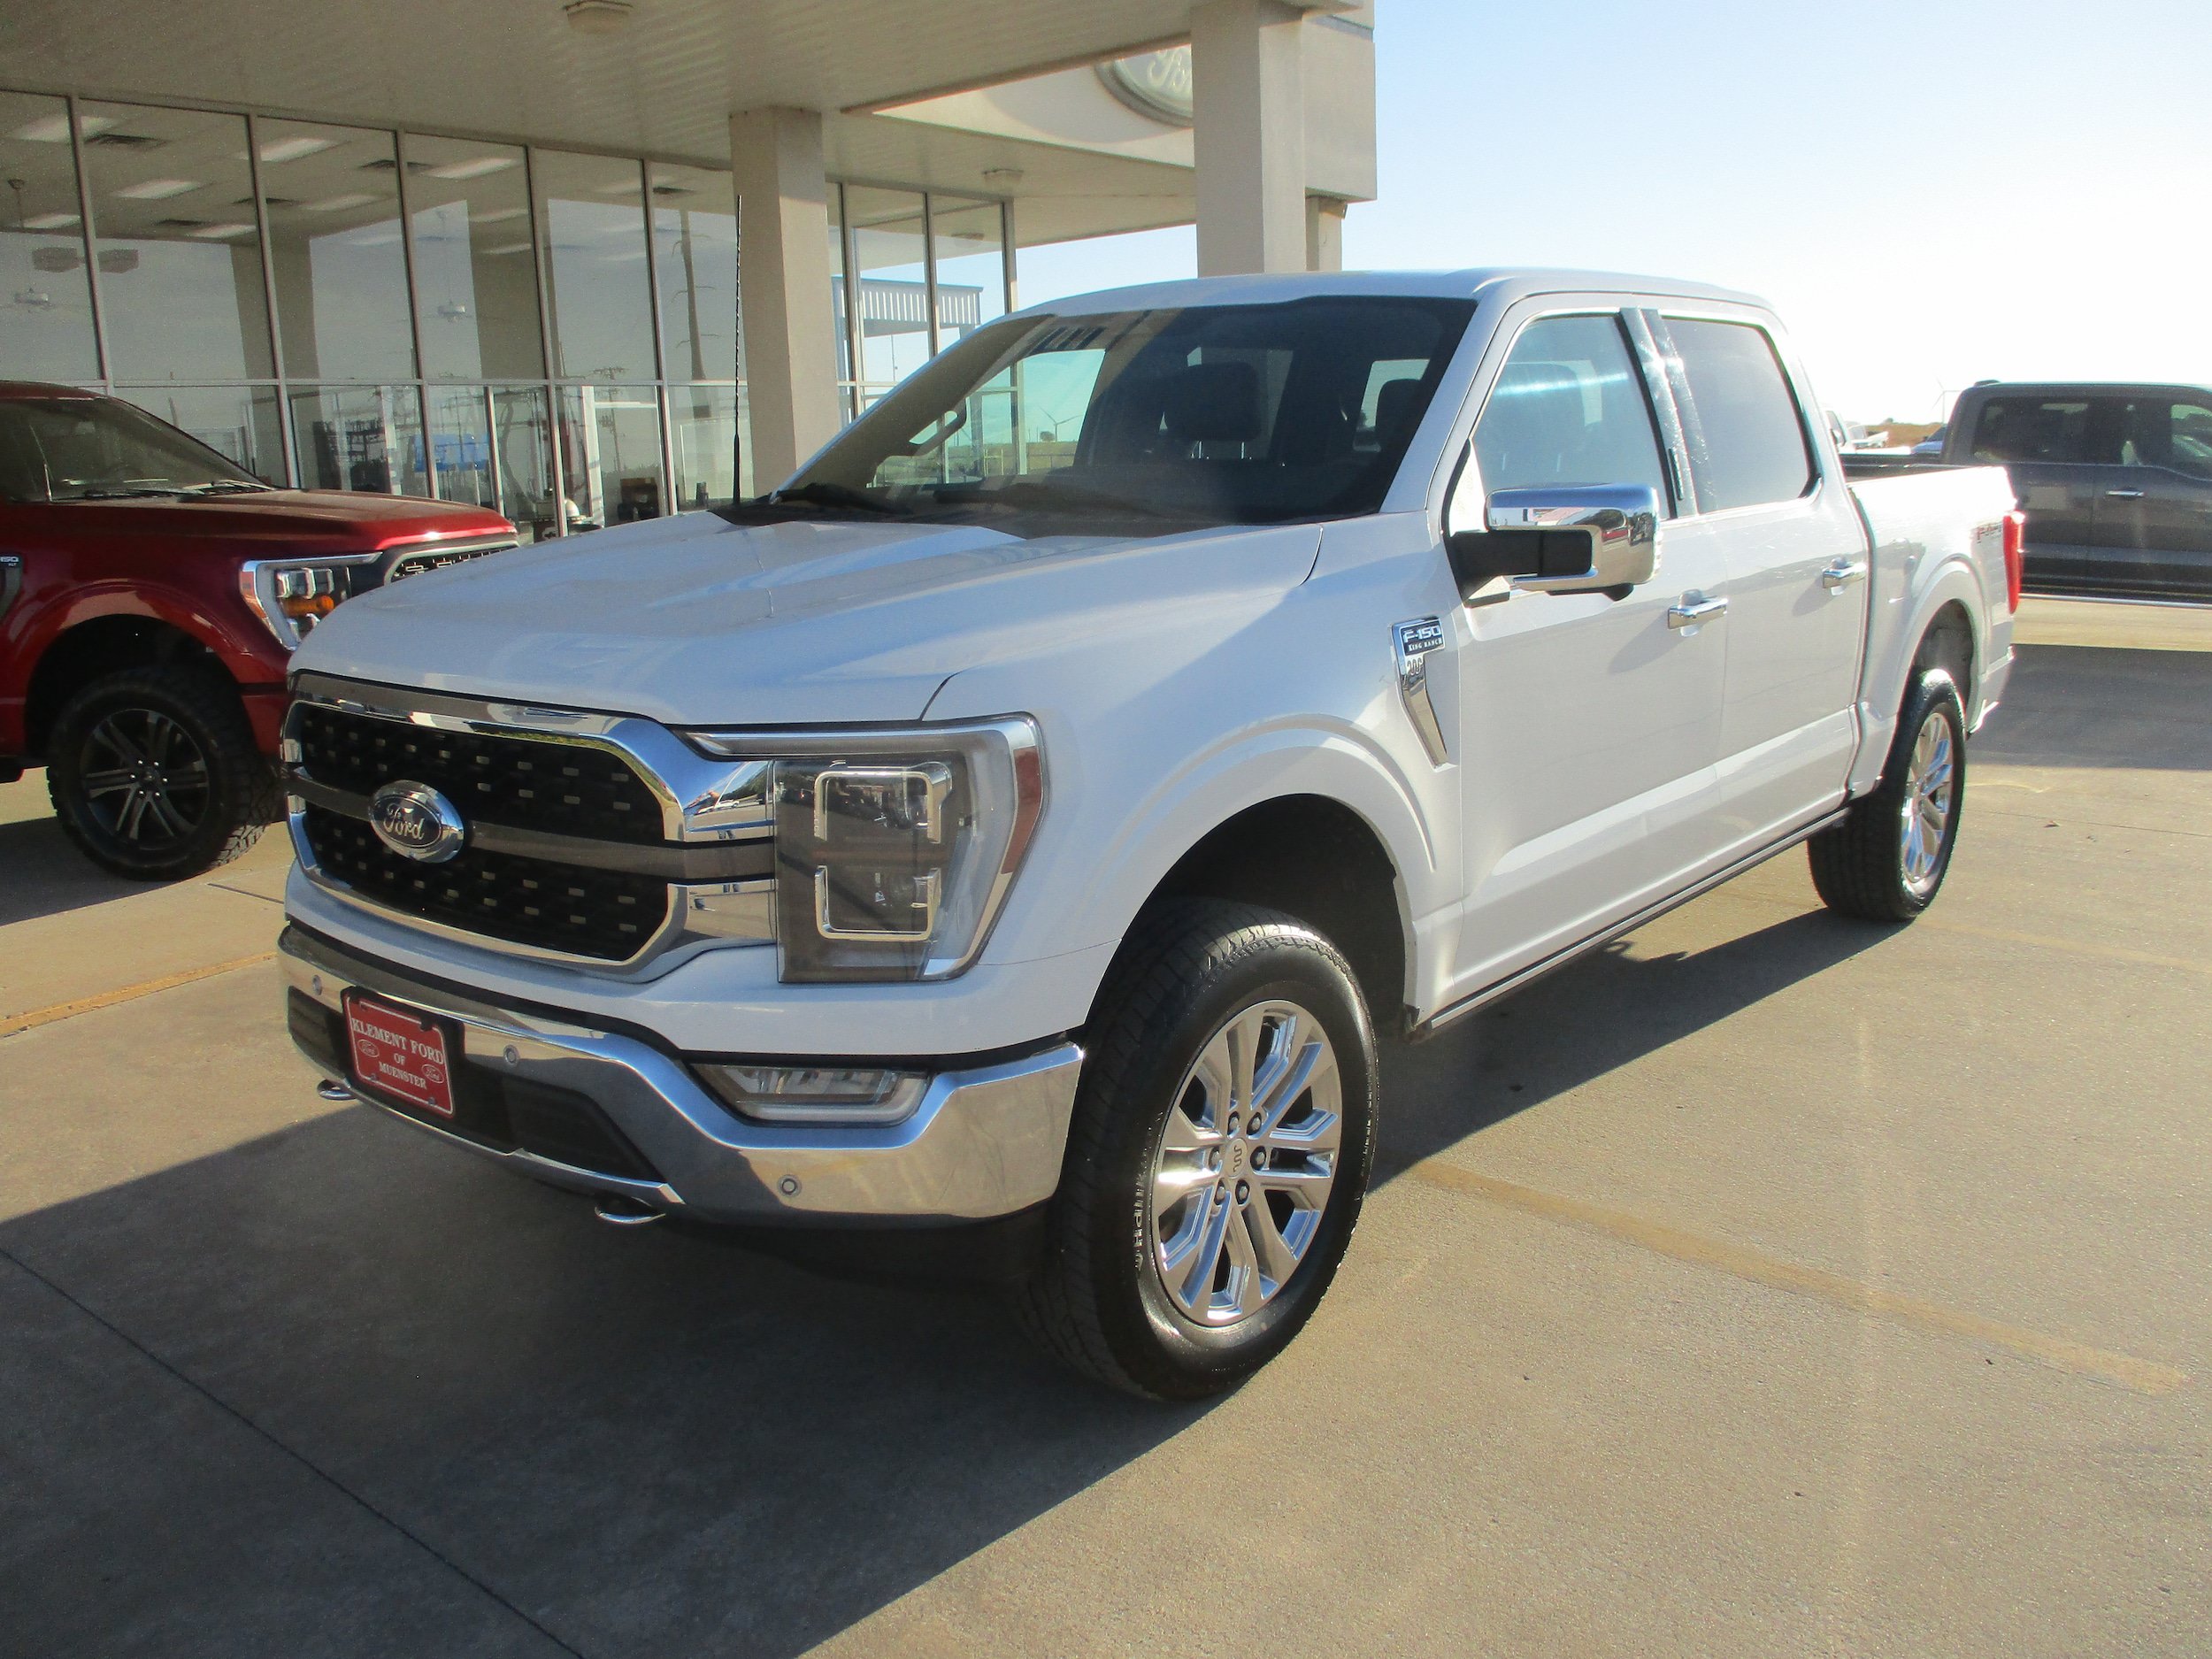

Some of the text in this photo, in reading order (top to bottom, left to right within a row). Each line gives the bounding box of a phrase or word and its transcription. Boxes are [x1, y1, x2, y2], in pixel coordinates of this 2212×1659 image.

[1403, 625, 1441, 643] F-150
[1408, 637, 1443, 652] KING RANCH
[383, 803, 425, 841] Ford
[351, 1018, 444, 1065] KLEMENT FORD
[394, 1053, 406, 1066] OF
[379, 1061, 427, 1090] MUENSTER
